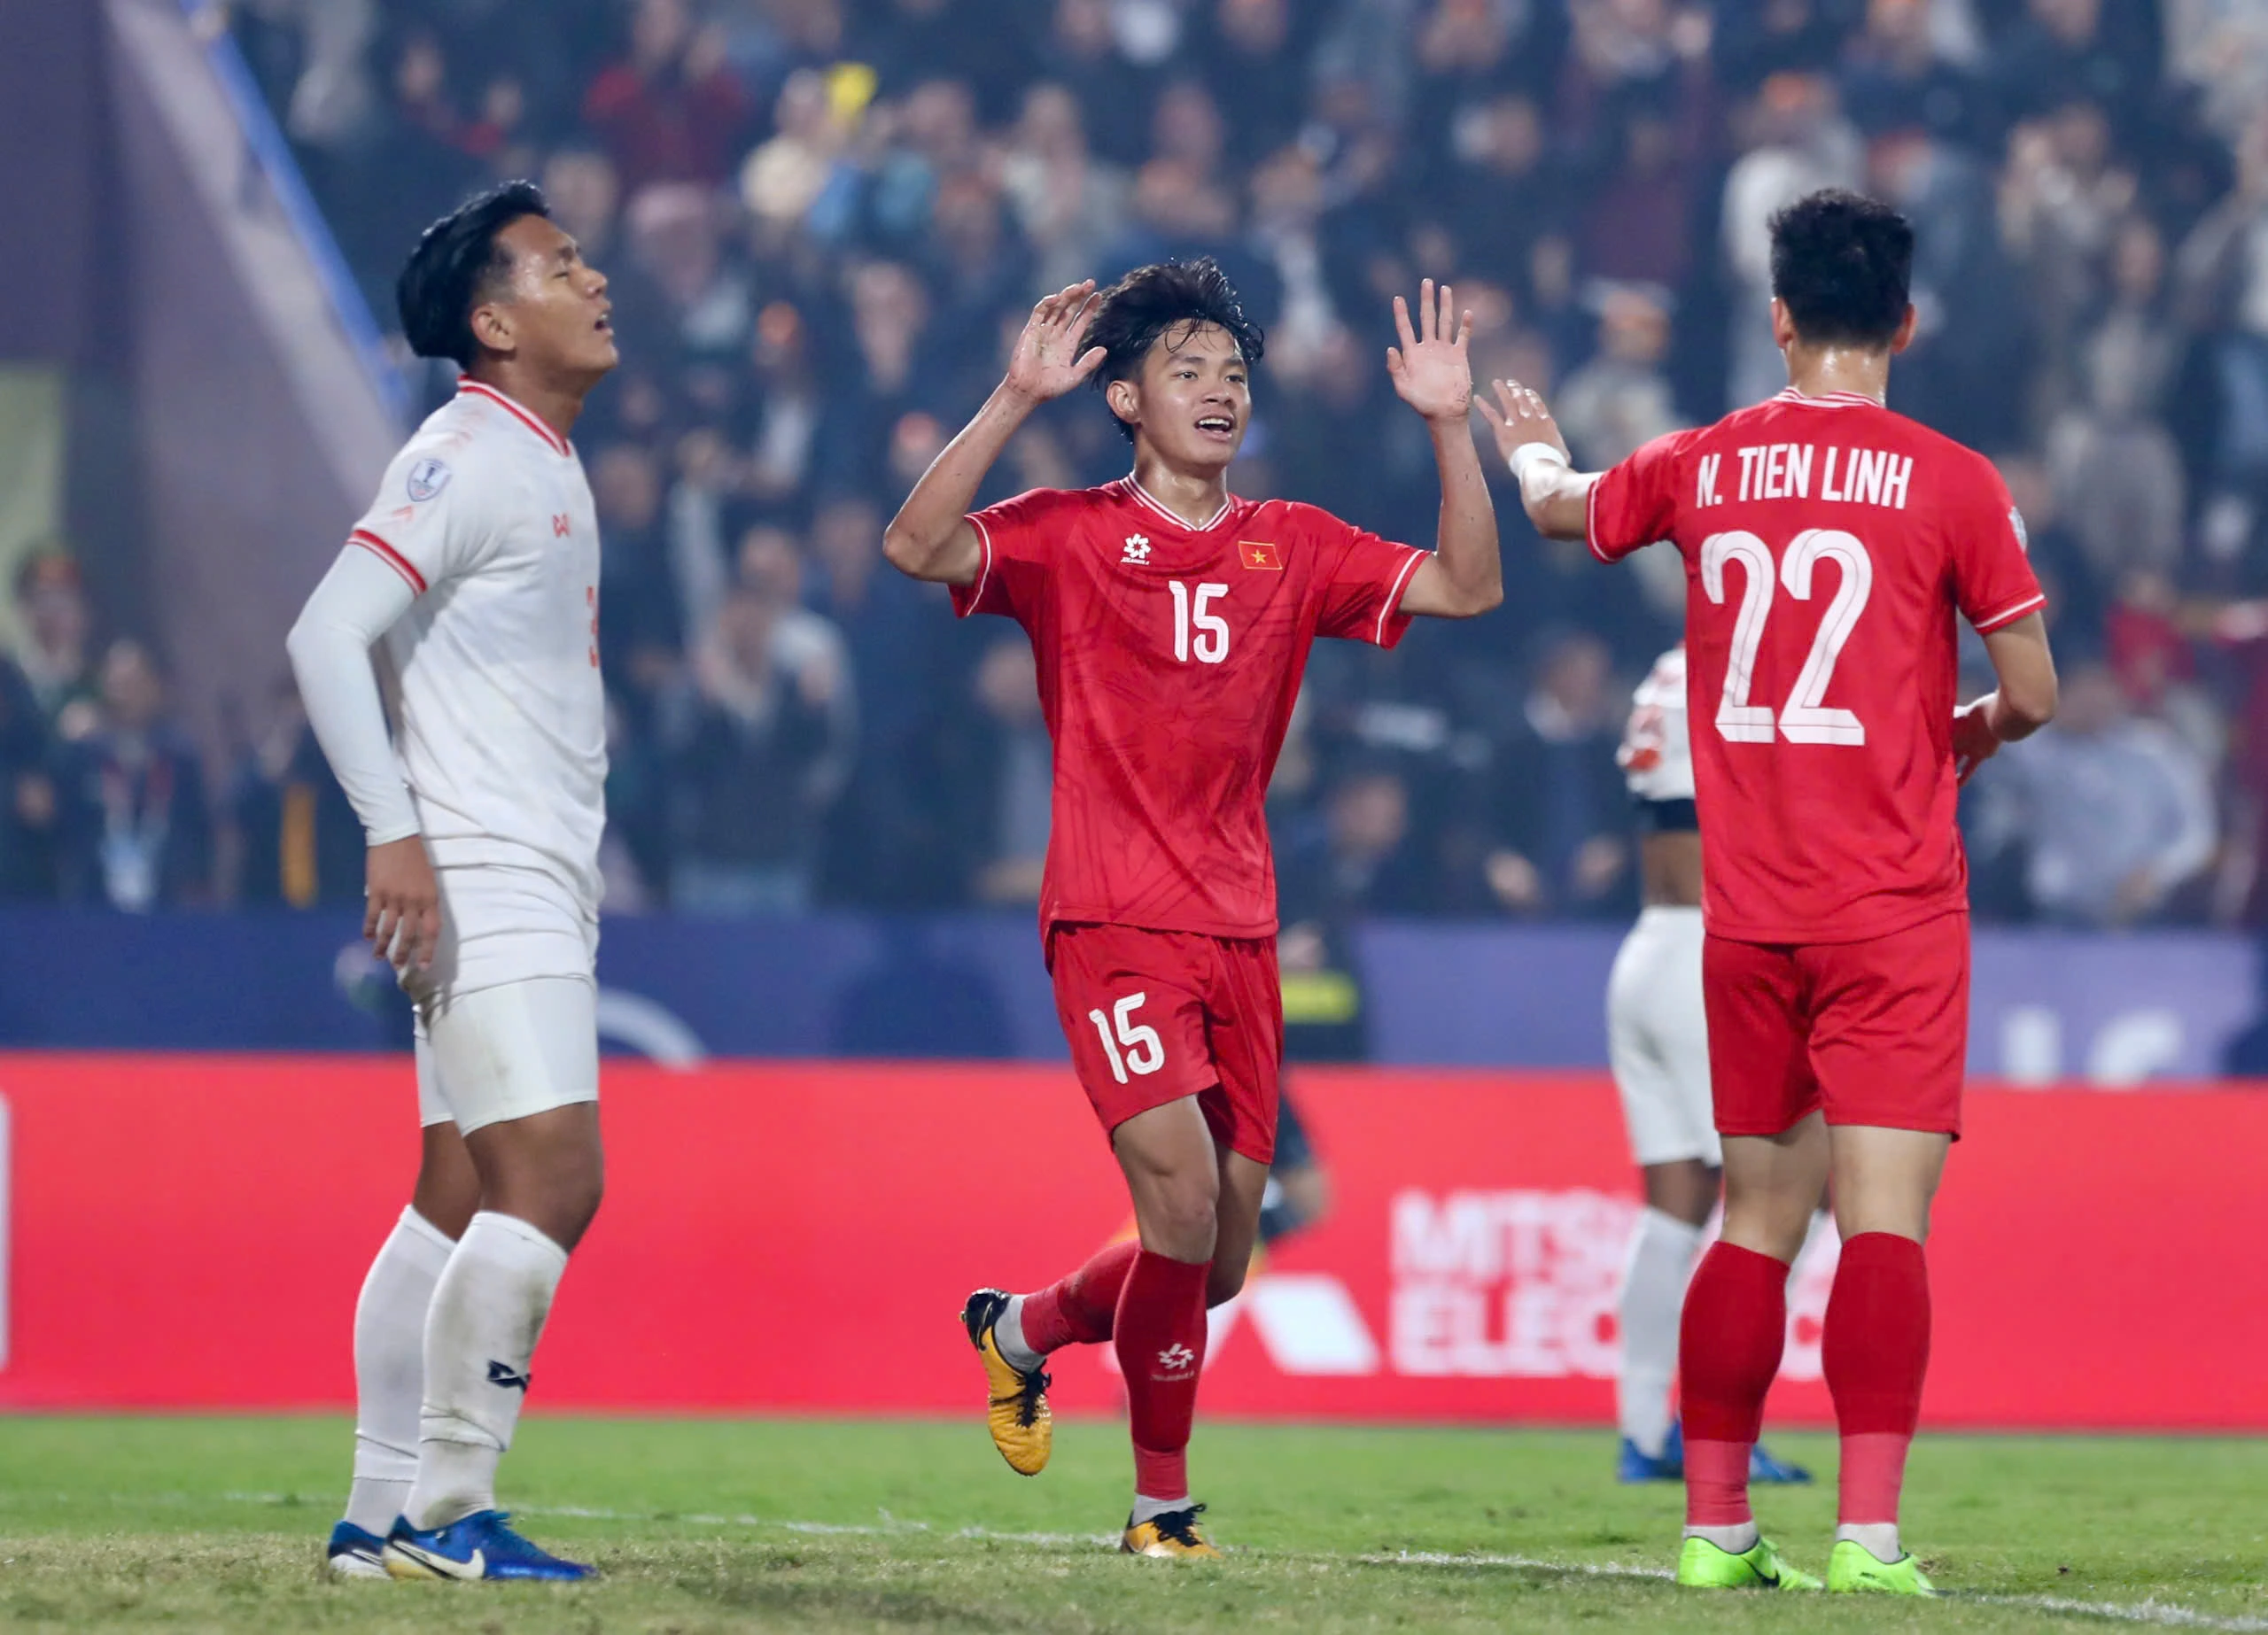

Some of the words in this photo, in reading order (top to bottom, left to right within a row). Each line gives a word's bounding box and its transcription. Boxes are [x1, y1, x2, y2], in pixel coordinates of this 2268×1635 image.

[1696, 453, 1723, 508] N.
[1737, 443, 1814, 502] TIEN
[1821, 446, 1914, 509] LINH
[1168, 579, 1230, 664] 15
[1699, 528, 1873, 746] 22
[1088, 990, 1166, 1085] 15
